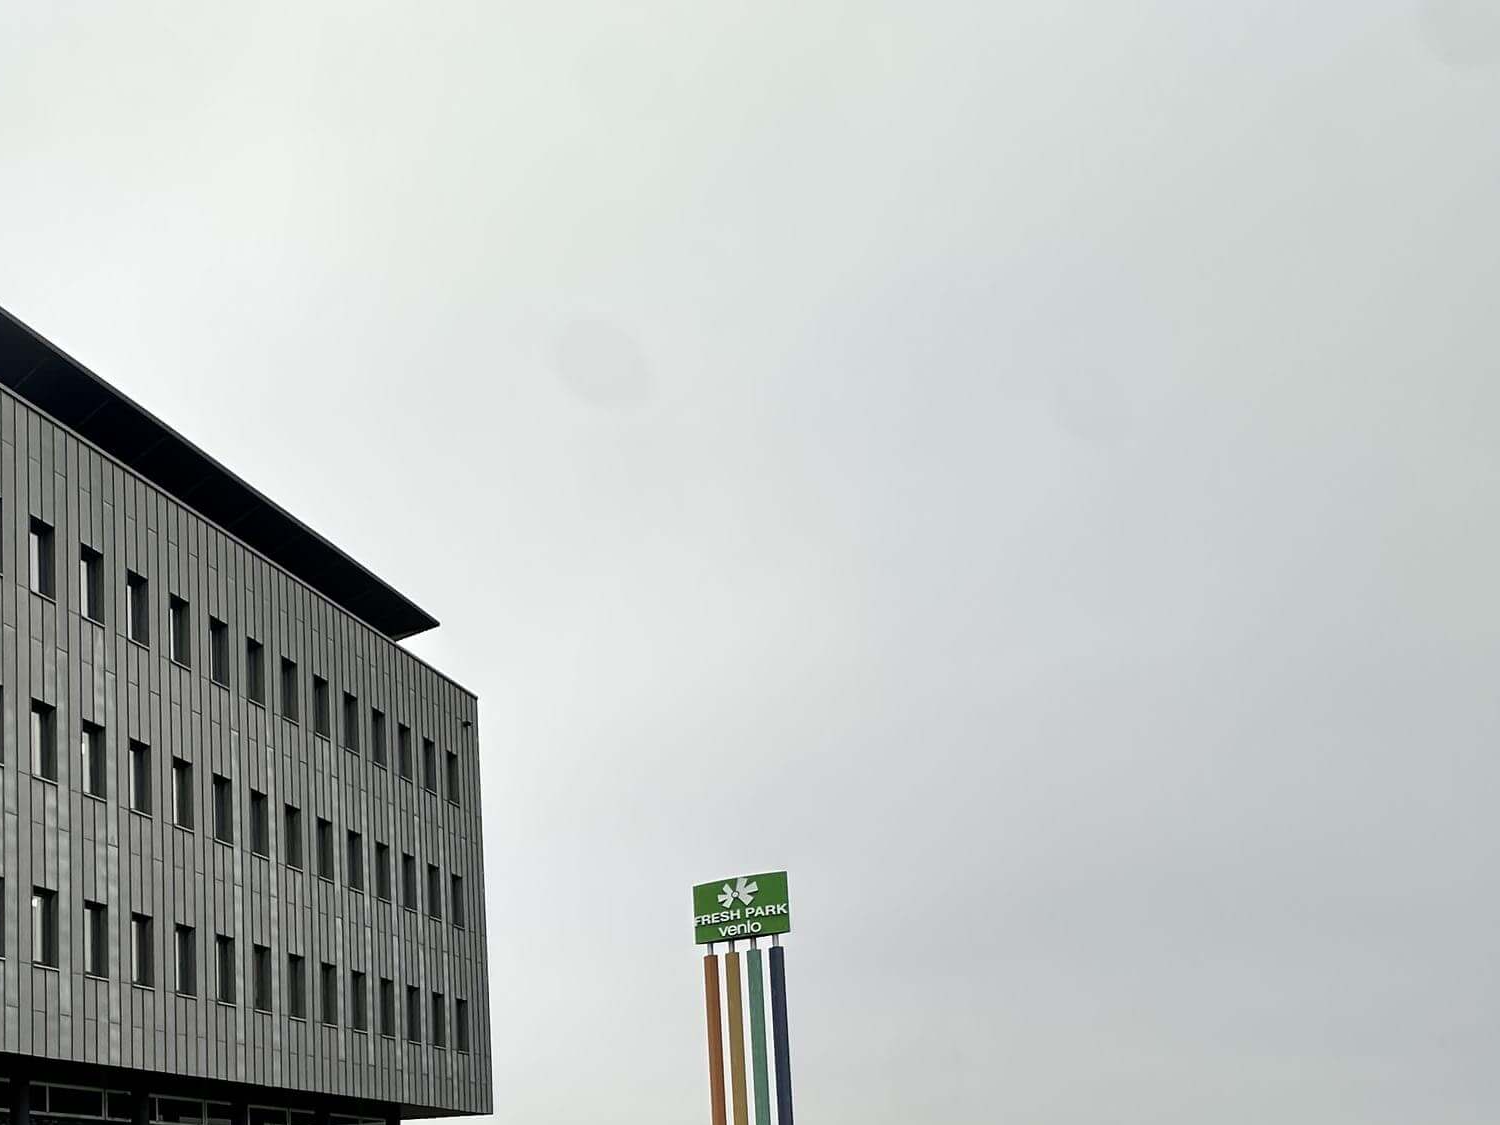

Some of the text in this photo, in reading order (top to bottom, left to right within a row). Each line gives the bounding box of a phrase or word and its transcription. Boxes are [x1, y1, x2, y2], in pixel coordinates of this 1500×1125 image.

[694, 903, 788, 927] FRESH PARK
[719, 920, 762, 937] venlo
